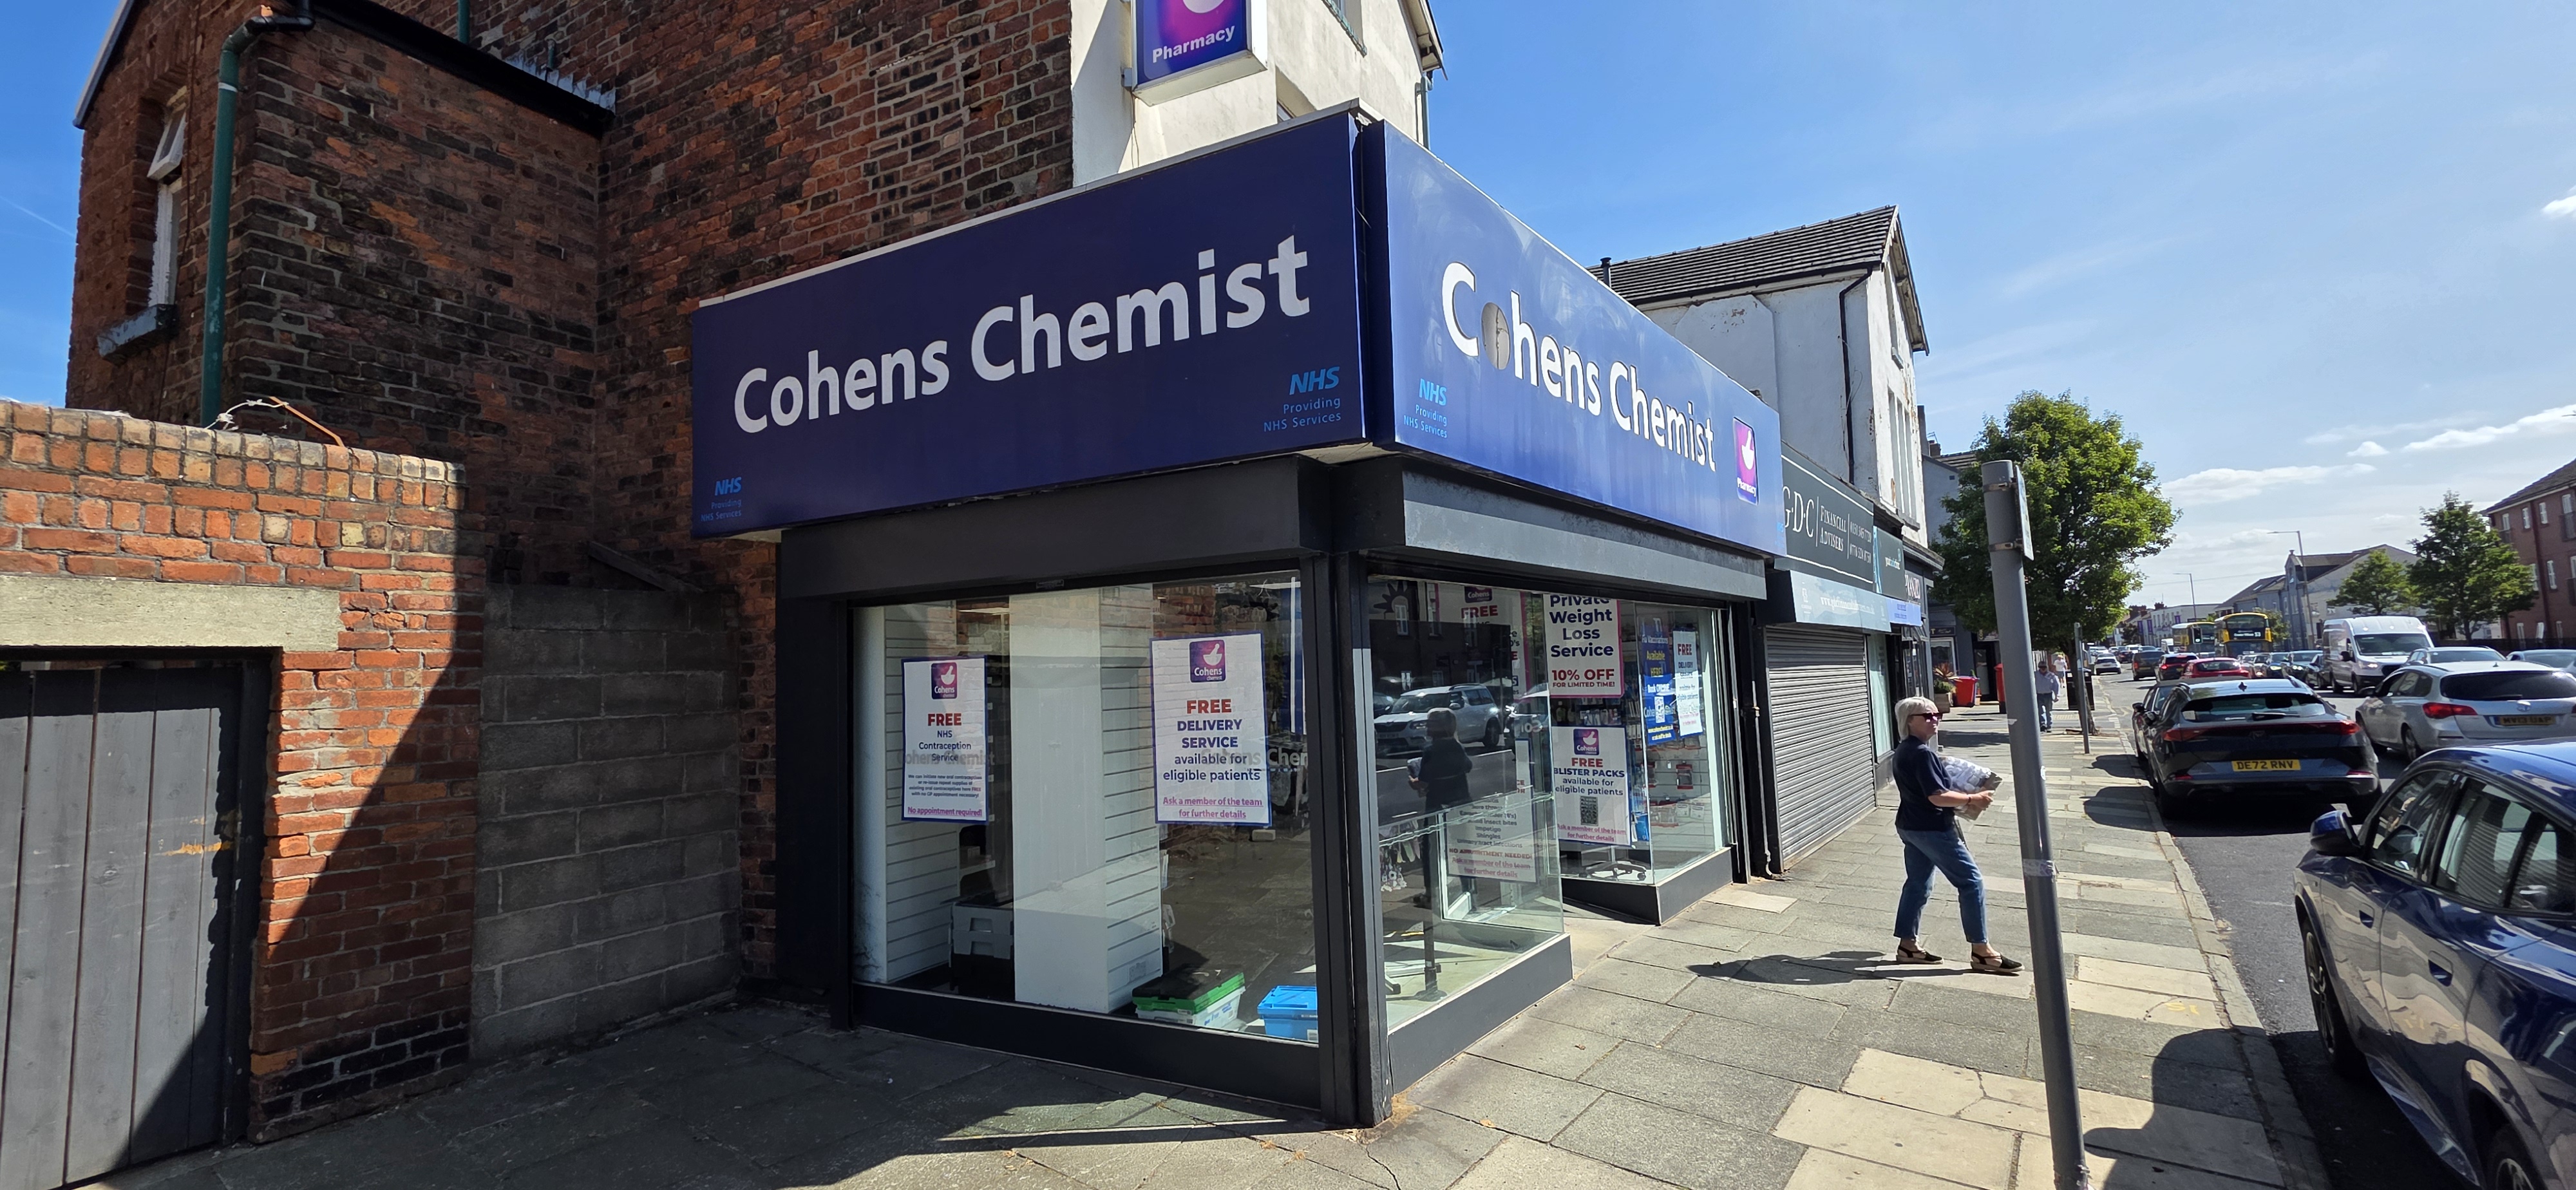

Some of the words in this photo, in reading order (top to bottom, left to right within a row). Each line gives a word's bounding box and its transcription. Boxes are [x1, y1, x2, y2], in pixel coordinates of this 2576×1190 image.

[1153, 26, 1235, 63] Pharmacy
[734, 338, 950, 433] Cohens
[971, 235, 1309, 381] Chemist
[1289, 366, 1340, 395] NHS
[1419, 378, 1446, 406] NHS
[1283, 397, 1340, 414] Providing
[1416, 404, 1447, 427] Providing
[1610, 361, 1716, 471] Chemist
[1264, 419, 1287, 432] NHS
[1293, 413, 1341, 428] Services
[1404, 415, 1418, 429] NHS
[1421, 420, 1447, 438] Services
[714, 477, 742, 496] NHS
[1737, 477, 1757, 497] Pharmacy
[711, 500, 742, 509] Providing
[701, 513, 714, 522] NHS
[716, 510, 742, 520] Services
[1461, 605, 1498, 618] FREE
[1549, 609, 1613, 625] Weight
[1563, 628, 1600, 640] Loss
[1551, 642, 1614, 657] Service
[1677, 643, 1692, 656] FREE
[1194, 667, 1222, 676] Cohens
[1552, 669, 1580, 681] 10%
[1584, 669, 1615, 680] OFF
[934, 686, 955, 694] Cohens
[1186, 699, 1232, 713] FREE
[927, 713, 961, 726] FREE
[1177, 719, 1242, 731] DELIVERY
[919, 741, 971, 751] Contraception
[1182, 737, 1238, 748] SERVICE
[932, 753, 958, 761] Service
[1175, 753, 1227, 765] available
[1230, 753, 1247, 764] for
[1571, 757, 1604, 768] FREE
[2237, 761, 2268, 770] DE72
[2270, 760, 2293, 769] RNV
[1163, 770, 1207, 783] eligible
[1210, 770, 1260, 782] patients
[1554, 768, 1589, 776] BLISTER
[1593, 770, 1625, 778] PACKS
[1563, 777, 1600, 786] available
[1555, 785, 1585, 795] eligible
[1587, 787, 1624, 796] patients
[1163, 797, 1177, 805] Ask
[1218, 797, 1227, 806] of
[917, 807, 955, 815] appointment
[956, 808, 983, 817] required!
[1179, 809, 1190, 818] for
[1191, 809, 1218, 818] further
[1220, 810, 1246, 818] details
